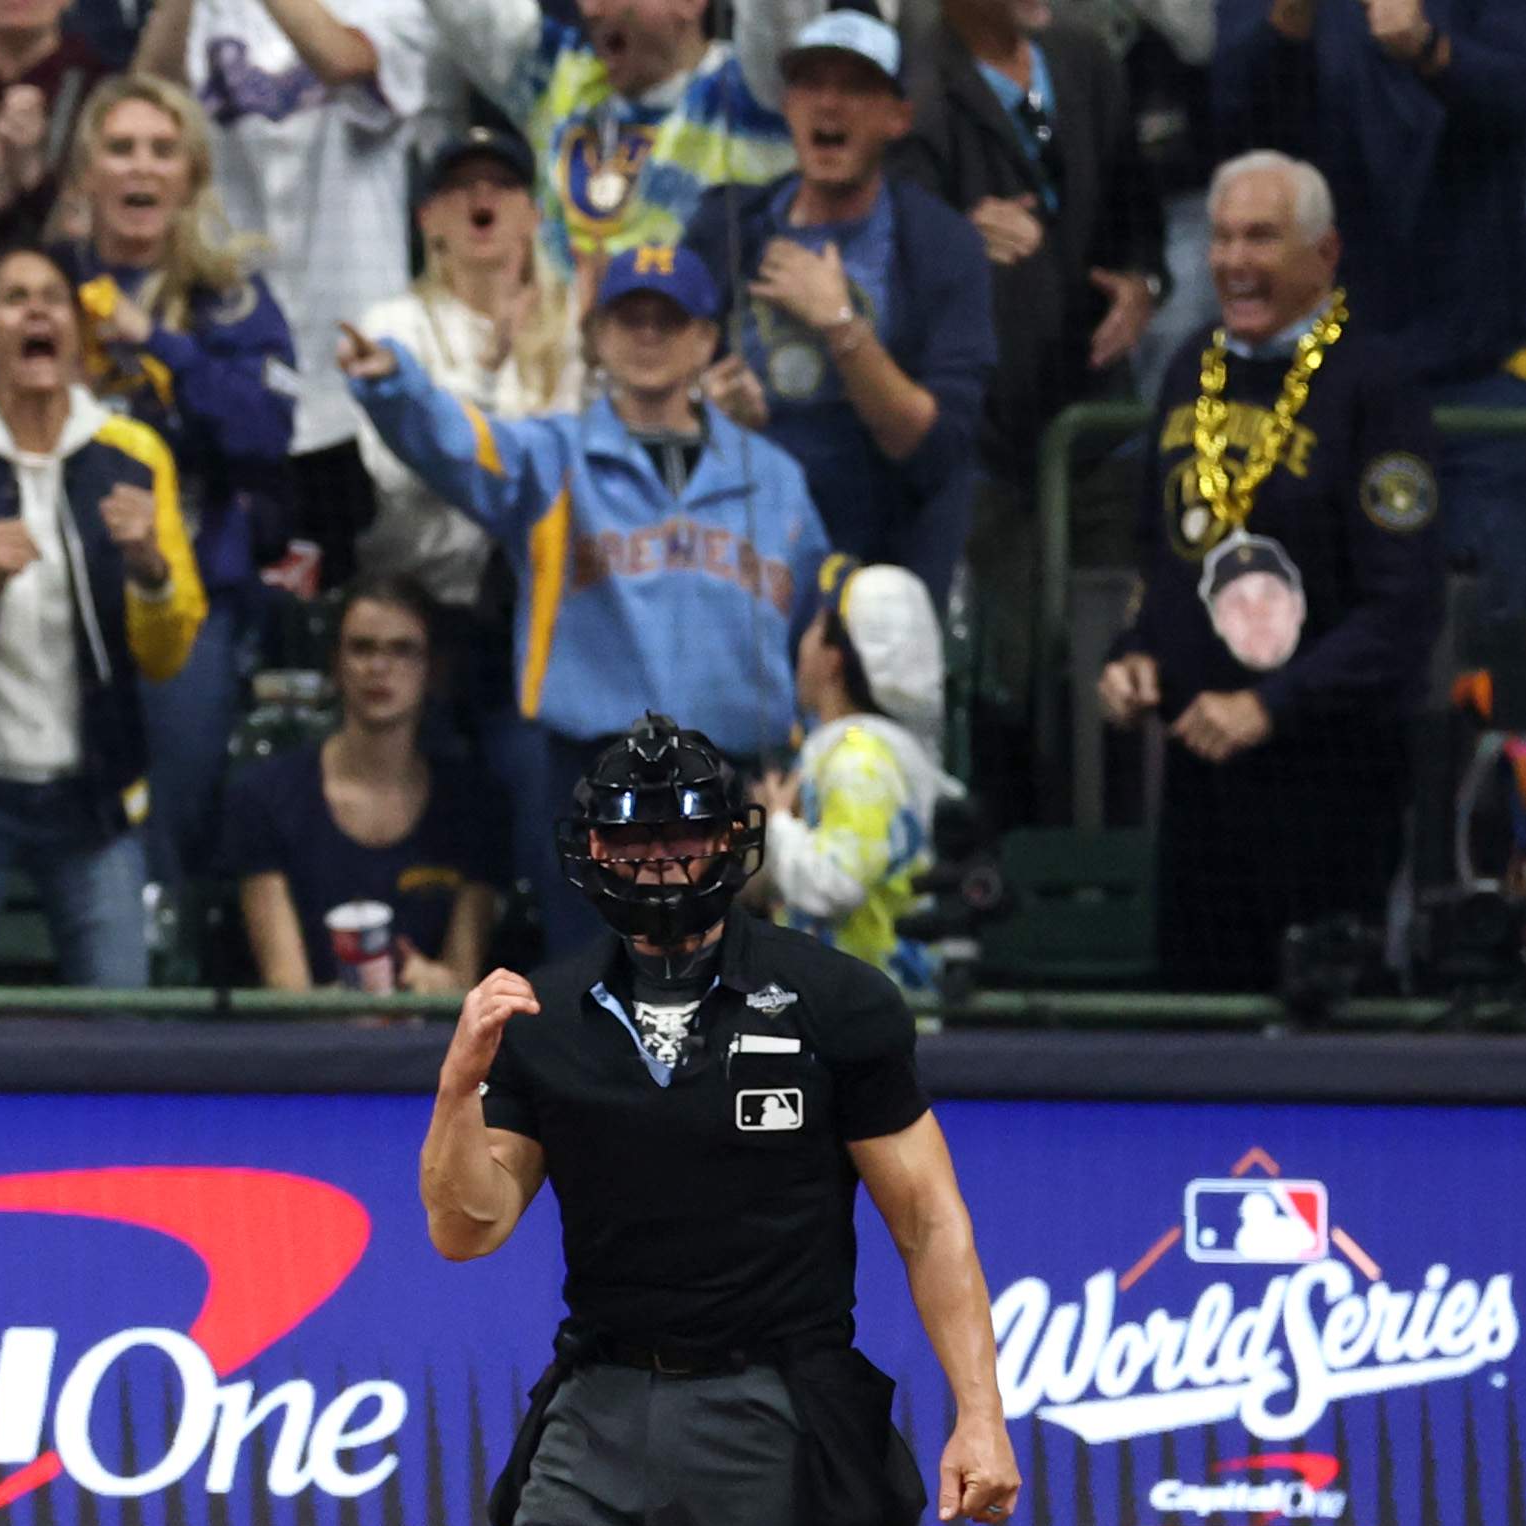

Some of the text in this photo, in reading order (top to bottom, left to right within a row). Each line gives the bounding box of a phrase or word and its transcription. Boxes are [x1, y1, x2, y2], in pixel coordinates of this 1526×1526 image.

[54, 1325, 408, 1498] One
[989, 1258, 1520, 1441] World Series
